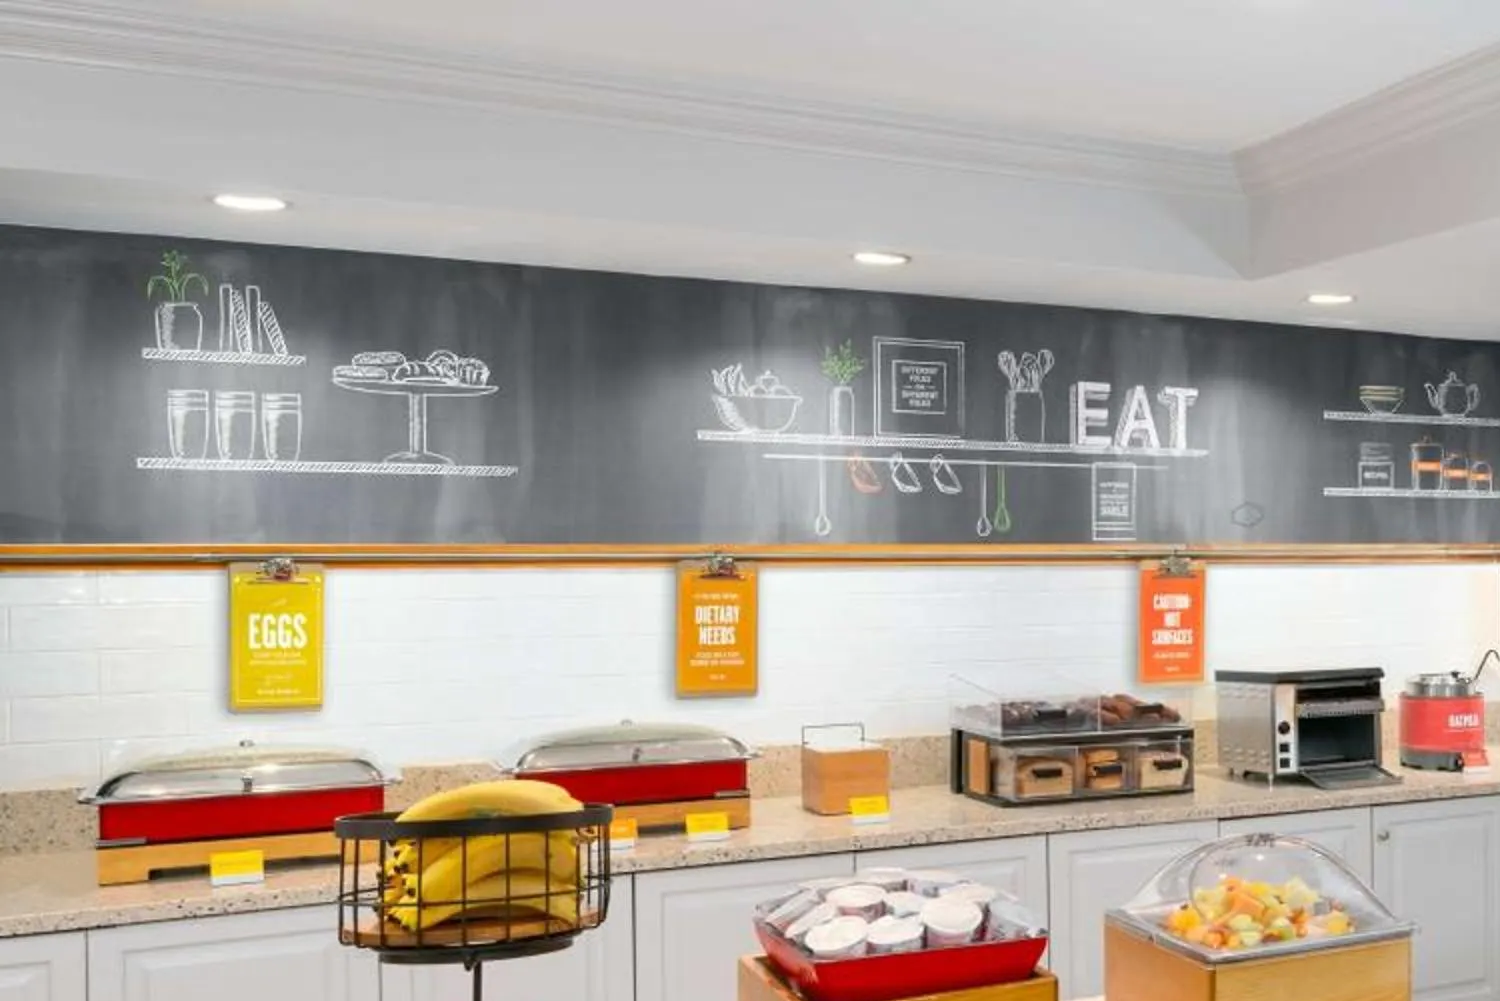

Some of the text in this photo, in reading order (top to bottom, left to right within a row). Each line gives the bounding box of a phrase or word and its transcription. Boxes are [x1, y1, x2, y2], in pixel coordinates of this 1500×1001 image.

[1069, 381, 1199, 451] EAT
[695, 605, 740, 625] DIETARY
[248, 612, 308, 649] EGGS
[699, 625, 736, 645] NEEDS
